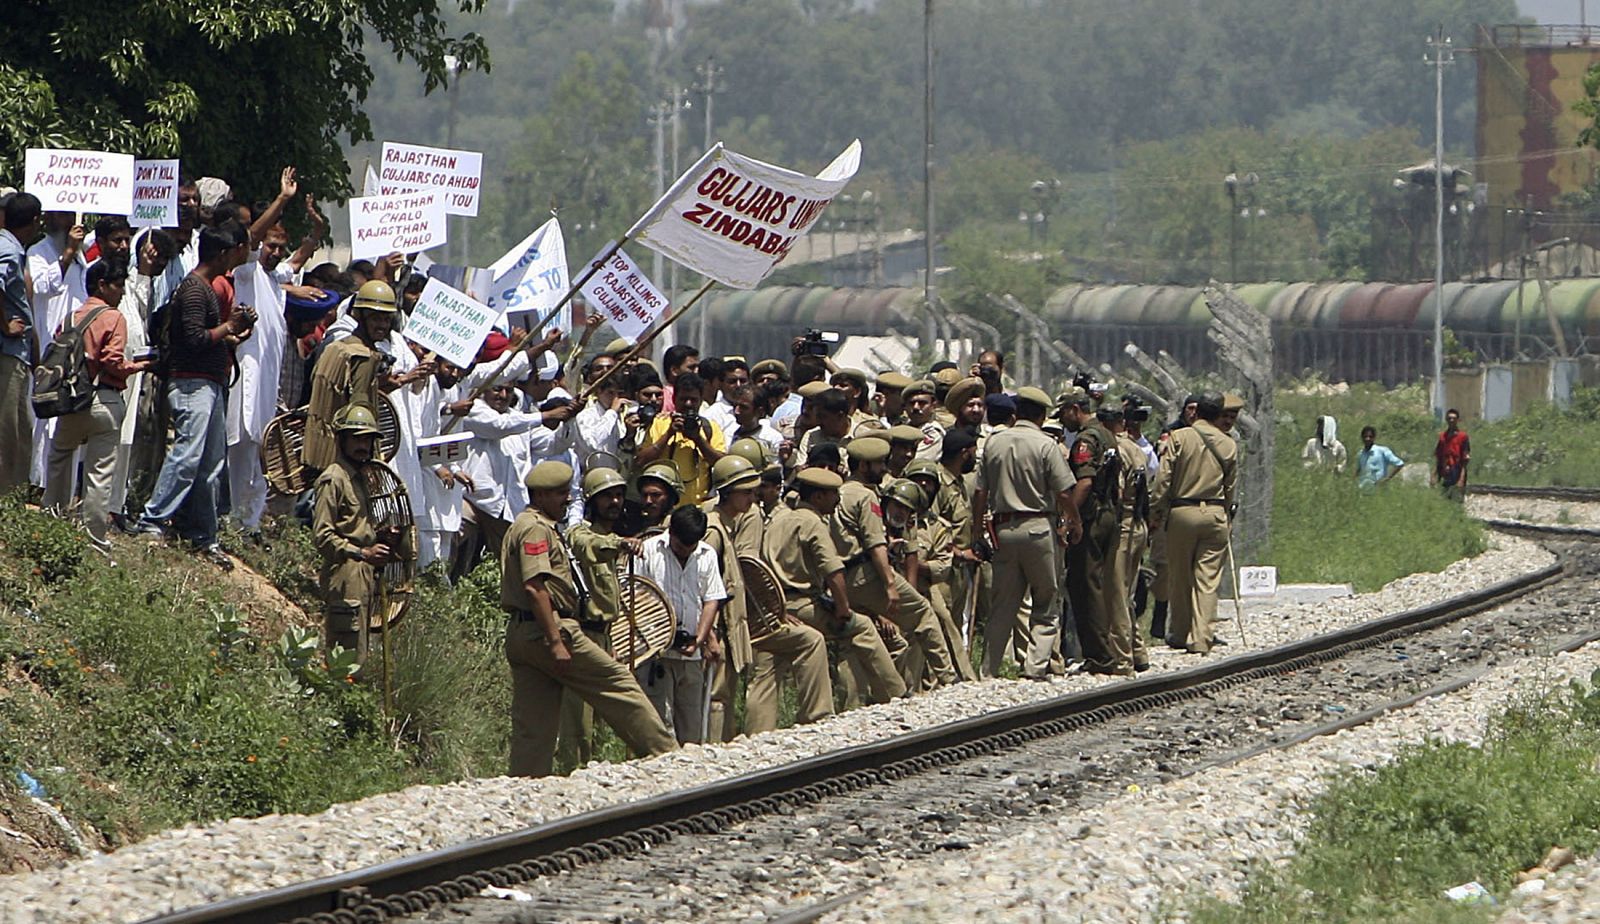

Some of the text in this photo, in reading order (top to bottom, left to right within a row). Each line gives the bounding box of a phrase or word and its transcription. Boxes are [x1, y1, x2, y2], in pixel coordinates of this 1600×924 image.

[48, 154, 103, 170] DISMISS
[385, 148, 457, 170] RAJASTHAN
[34, 172, 120, 188] RAJASTHAN
[136, 163, 174, 181] DON'T KILL
[382, 168, 480, 190] GUJJARS GO AHEAD
[56, 190, 99, 205] GOVT.
[134, 186, 172, 200] INNOCENT
[381, 185, 399, 196] WE
[451, 194, 473, 208] YOU
[697, 167, 796, 225] GUJJARS
[362, 194, 434, 214] RAJASTHAN
[380, 210, 422, 224] CHALO
[357, 221, 428, 241] RAJASTHAN
[682, 202, 798, 257] ZINDABA
[392, 233, 432, 249] CHALO
[608, 250, 661, 308] TOP KILLINGS
[433, 290, 488, 326] RAJASTHAN
[593, 286, 628, 323] GUJJARS
[602, 271, 654, 324] RAJASTHAN'S
[408, 319, 421, 332] WE
[416, 324, 432, 338] ARE
[428, 330, 450, 348] WITH
[450, 322, 476, 340] AHEAD
